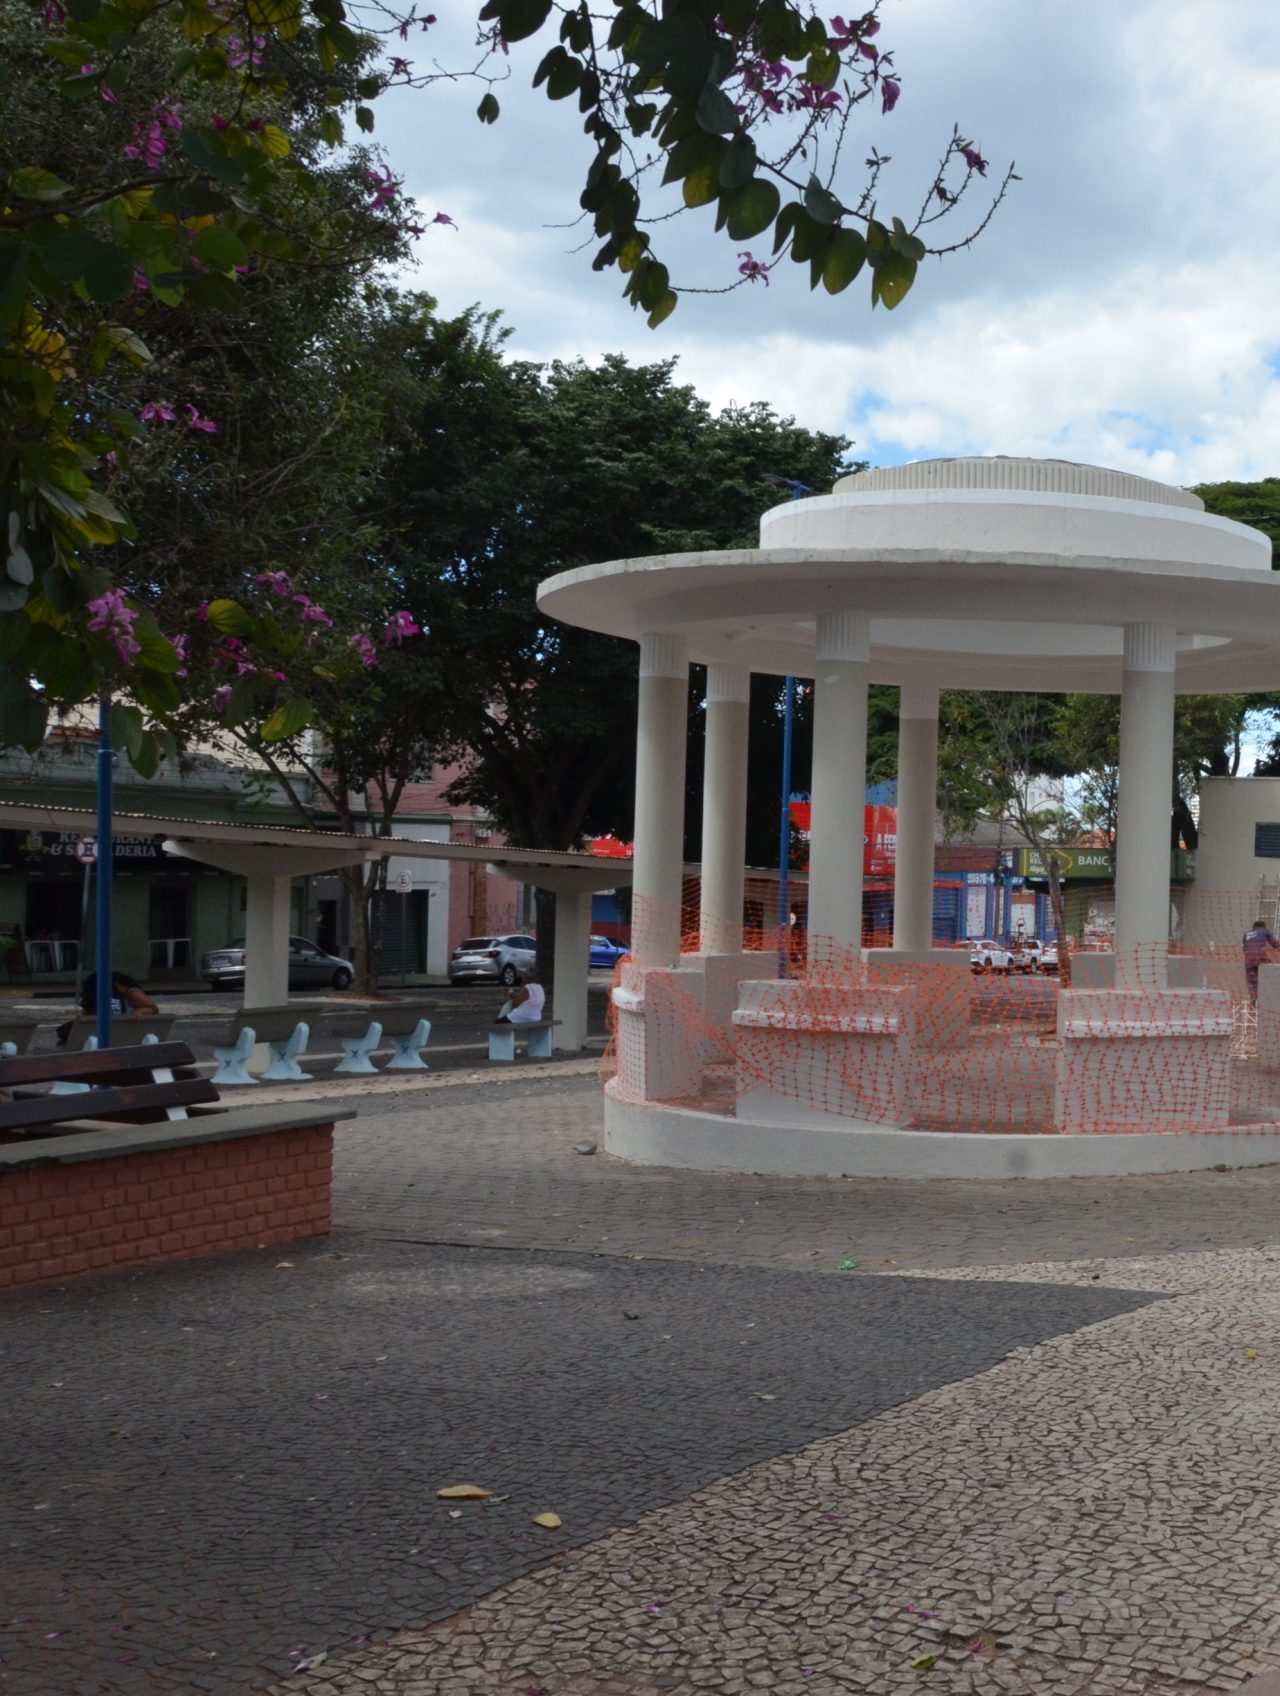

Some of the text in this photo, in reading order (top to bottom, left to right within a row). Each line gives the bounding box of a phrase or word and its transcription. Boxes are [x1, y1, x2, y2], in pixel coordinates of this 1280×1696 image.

[50, 844, 157, 857] & SDERIA
[1078, 855, 1111, 866] BANC
